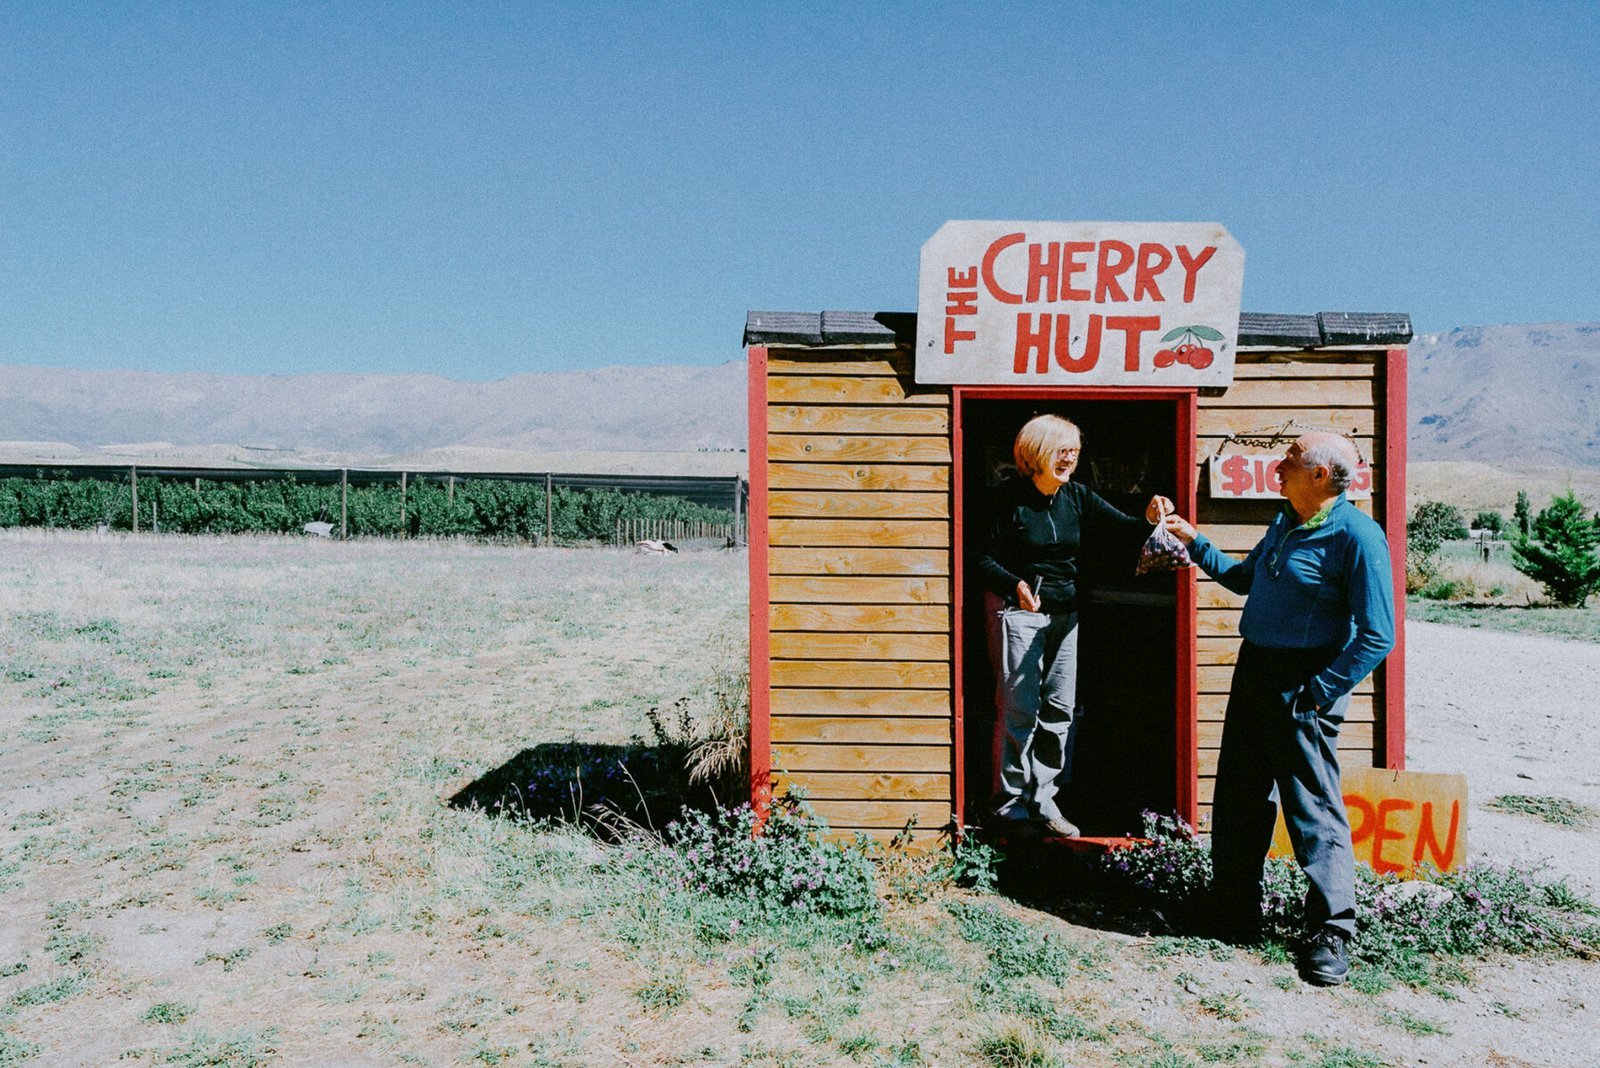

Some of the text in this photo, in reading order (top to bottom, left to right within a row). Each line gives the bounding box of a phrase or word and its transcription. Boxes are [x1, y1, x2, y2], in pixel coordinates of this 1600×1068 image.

[981, 232, 1217, 305] CHERRY
[945, 267, 977, 354] THE
[1014, 313, 1160, 374] HUT
[1341, 793, 1459, 876] PEN
